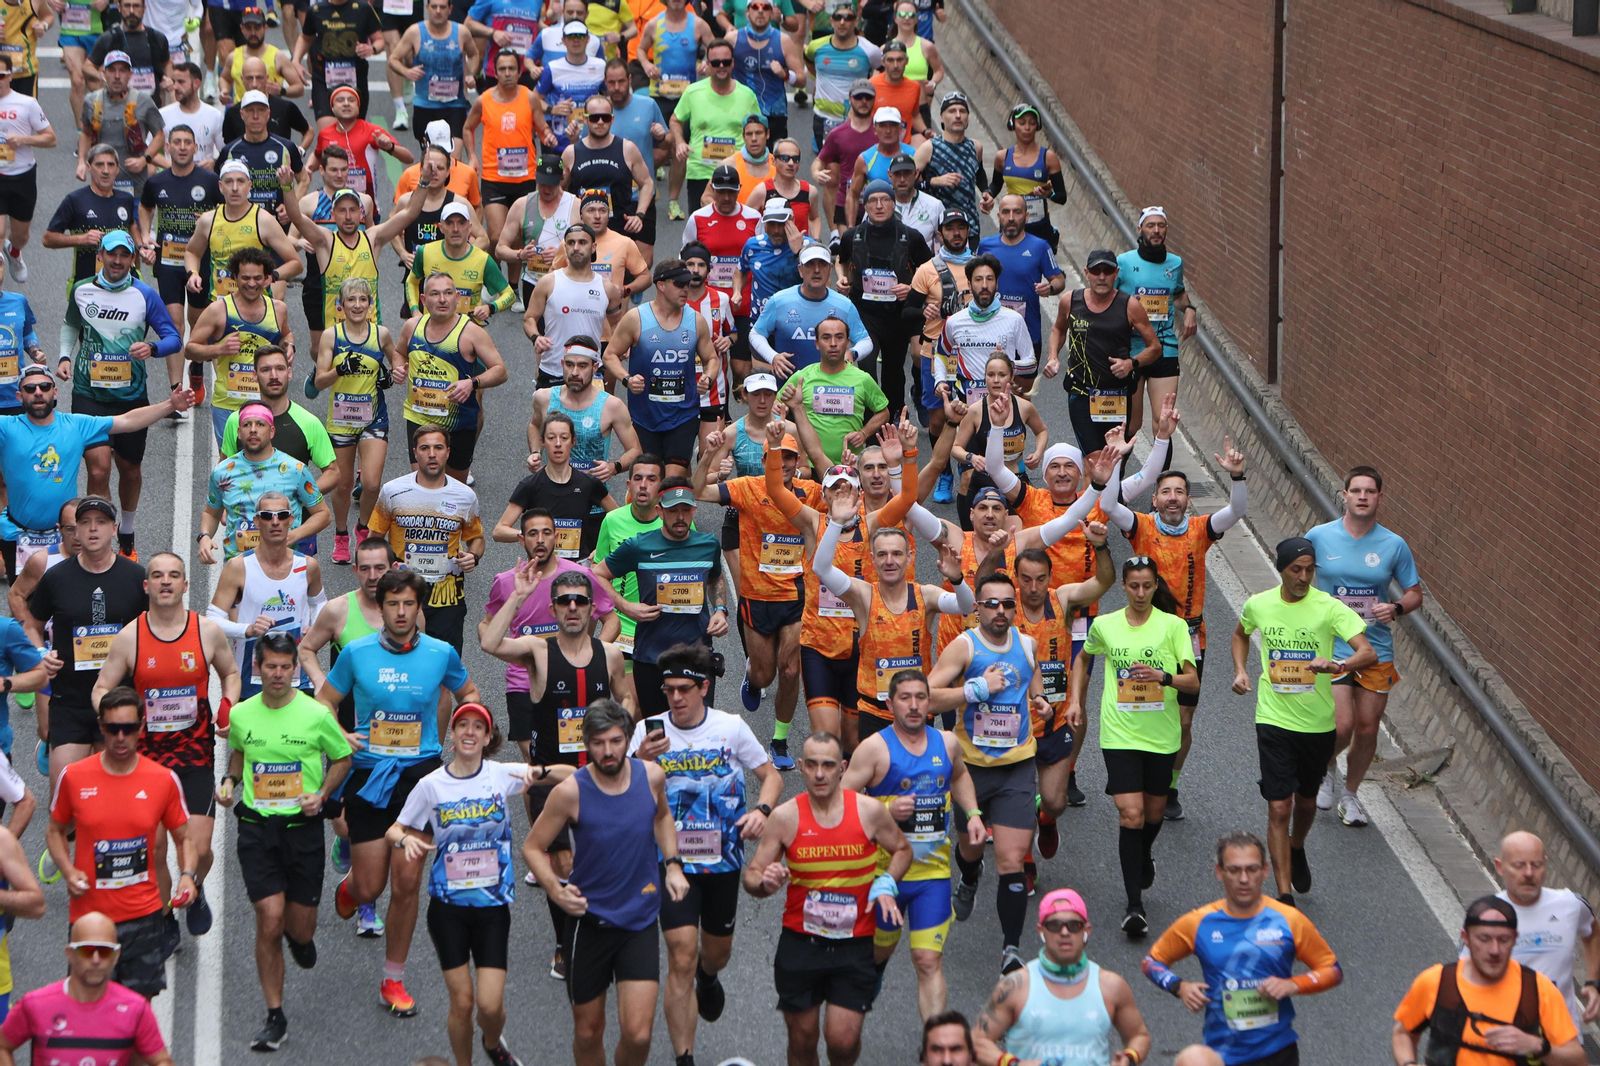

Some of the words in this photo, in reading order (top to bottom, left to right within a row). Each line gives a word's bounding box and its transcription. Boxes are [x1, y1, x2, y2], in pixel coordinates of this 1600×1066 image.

[578, 161, 592, 172] LONG
[874, 269, 895, 277] ZURICH
[98, 308, 129, 321] adm
[571, 307, 600, 316] outsystems
[959, 341, 997, 349] MARATÓN
[651, 349, 689, 363] ADS
[417, 368, 447, 377] BARANDA
[423, 380, 446, 389] ZURICH
[346, 395, 369, 403] ZURICH
[424, 516, 435, 528] NO
[405, 529, 450, 542] ABRANTES
[777, 535, 802, 544] ZURICH
[32, 538, 57, 546] ZURICH
[673, 574, 699, 582] ZURICH
[1184, 552, 1195, 617] MARCHENA
[1349, 588, 1374, 596] ZURICH
[1348, 601, 1364, 609] 6965
[89, 626, 118, 634] ZURICH
[1264, 627, 1284, 637] LIVE
[1266, 638, 1319, 651] DONATIONS
[1110, 648, 1129, 657] LIVE
[1283, 651, 1311, 660] ZURICH
[891, 659, 917, 668] ZURICH
[162, 687, 191, 697] ZURICH
[1131, 684, 1147, 692] 4461
[991, 704, 1016, 713] ZURICH
[387, 713, 416, 721] ZURICH
[990, 719, 1006, 727] 7041
[386, 728, 404, 736] 3761
[267, 764, 297, 773] ZURICH
[660, 756, 721, 774] SEVILLA
[916, 797, 943, 806] ZURICH
[440, 804, 498, 823] SEVILLA
[915, 812, 934, 822] 3297
[112, 838, 143, 850] ZURICH
[461, 841, 491, 850] ZURICH
[796, 843, 865, 859] SERPENTINE
[823, 893, 851, 904] ZURICH
[822, 909, 840, 919] 7034
